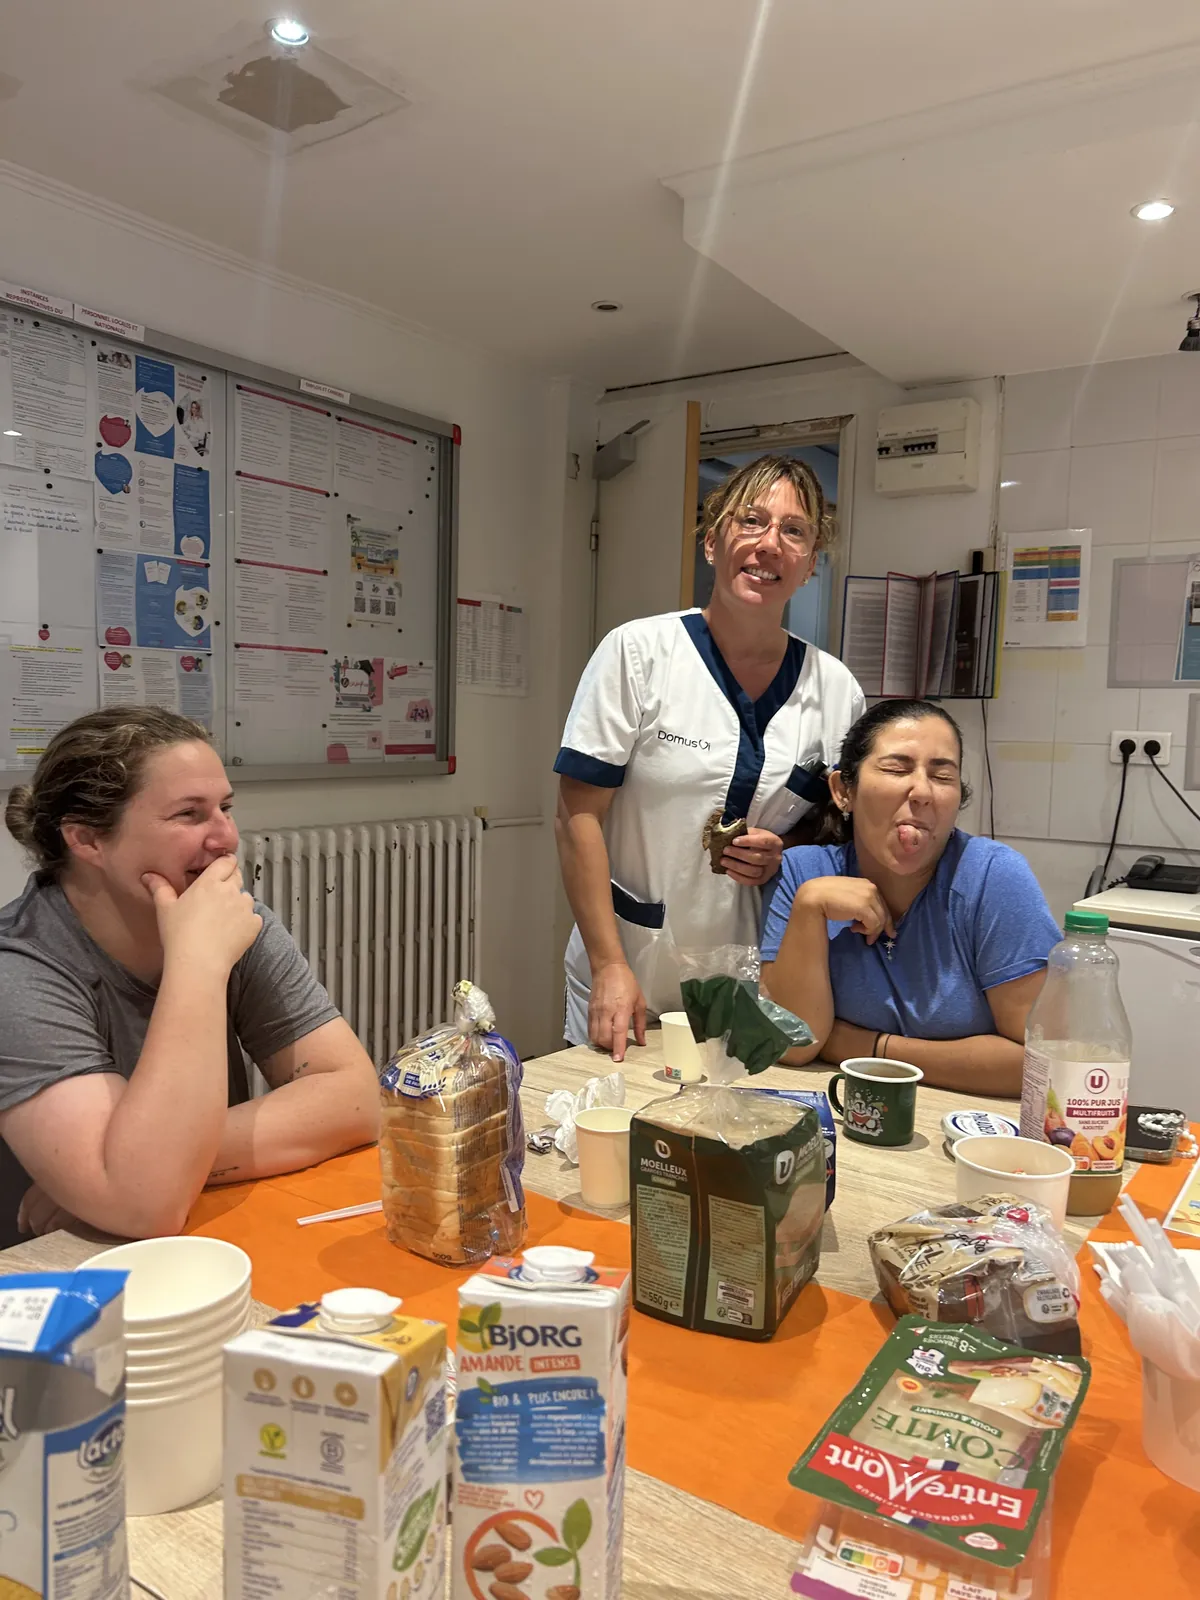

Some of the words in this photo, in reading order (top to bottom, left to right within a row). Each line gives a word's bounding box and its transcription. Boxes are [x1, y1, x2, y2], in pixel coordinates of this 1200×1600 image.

[81, 308, 111, 323] PERSONNEL
[1090, 1075, 1104, 1089] U
[1066, 1098, 1089, 1107] 100%
[1090, 1099, 1106, 1107] PUR
[1072, 1109, 1115, 1117] MULTIFRUITS
[640, 1157, 687, 1177] MOELLEUX
[648, 1291, 663, 1306] 550
[663, 1300, 669, 1310] g
[460, 1355, 525, 1373] AMANDE
[533, 1358, 577, 1370] INTENSE
[492, 1393, 509, 1407] BIO
[528, 1391, 551, 1405] PLUS
[552, 1388, 589, 1402] ENCORE
[915, 1406, 960, 1420] FONDANT
[972, 1418, 999, 1436] DOUX
[871, 1406, 1024, 1471] COMTÉ
[910, 1508, 975, 1523] FROMAGER
[962, 1585, 982, 1594] LAIT
